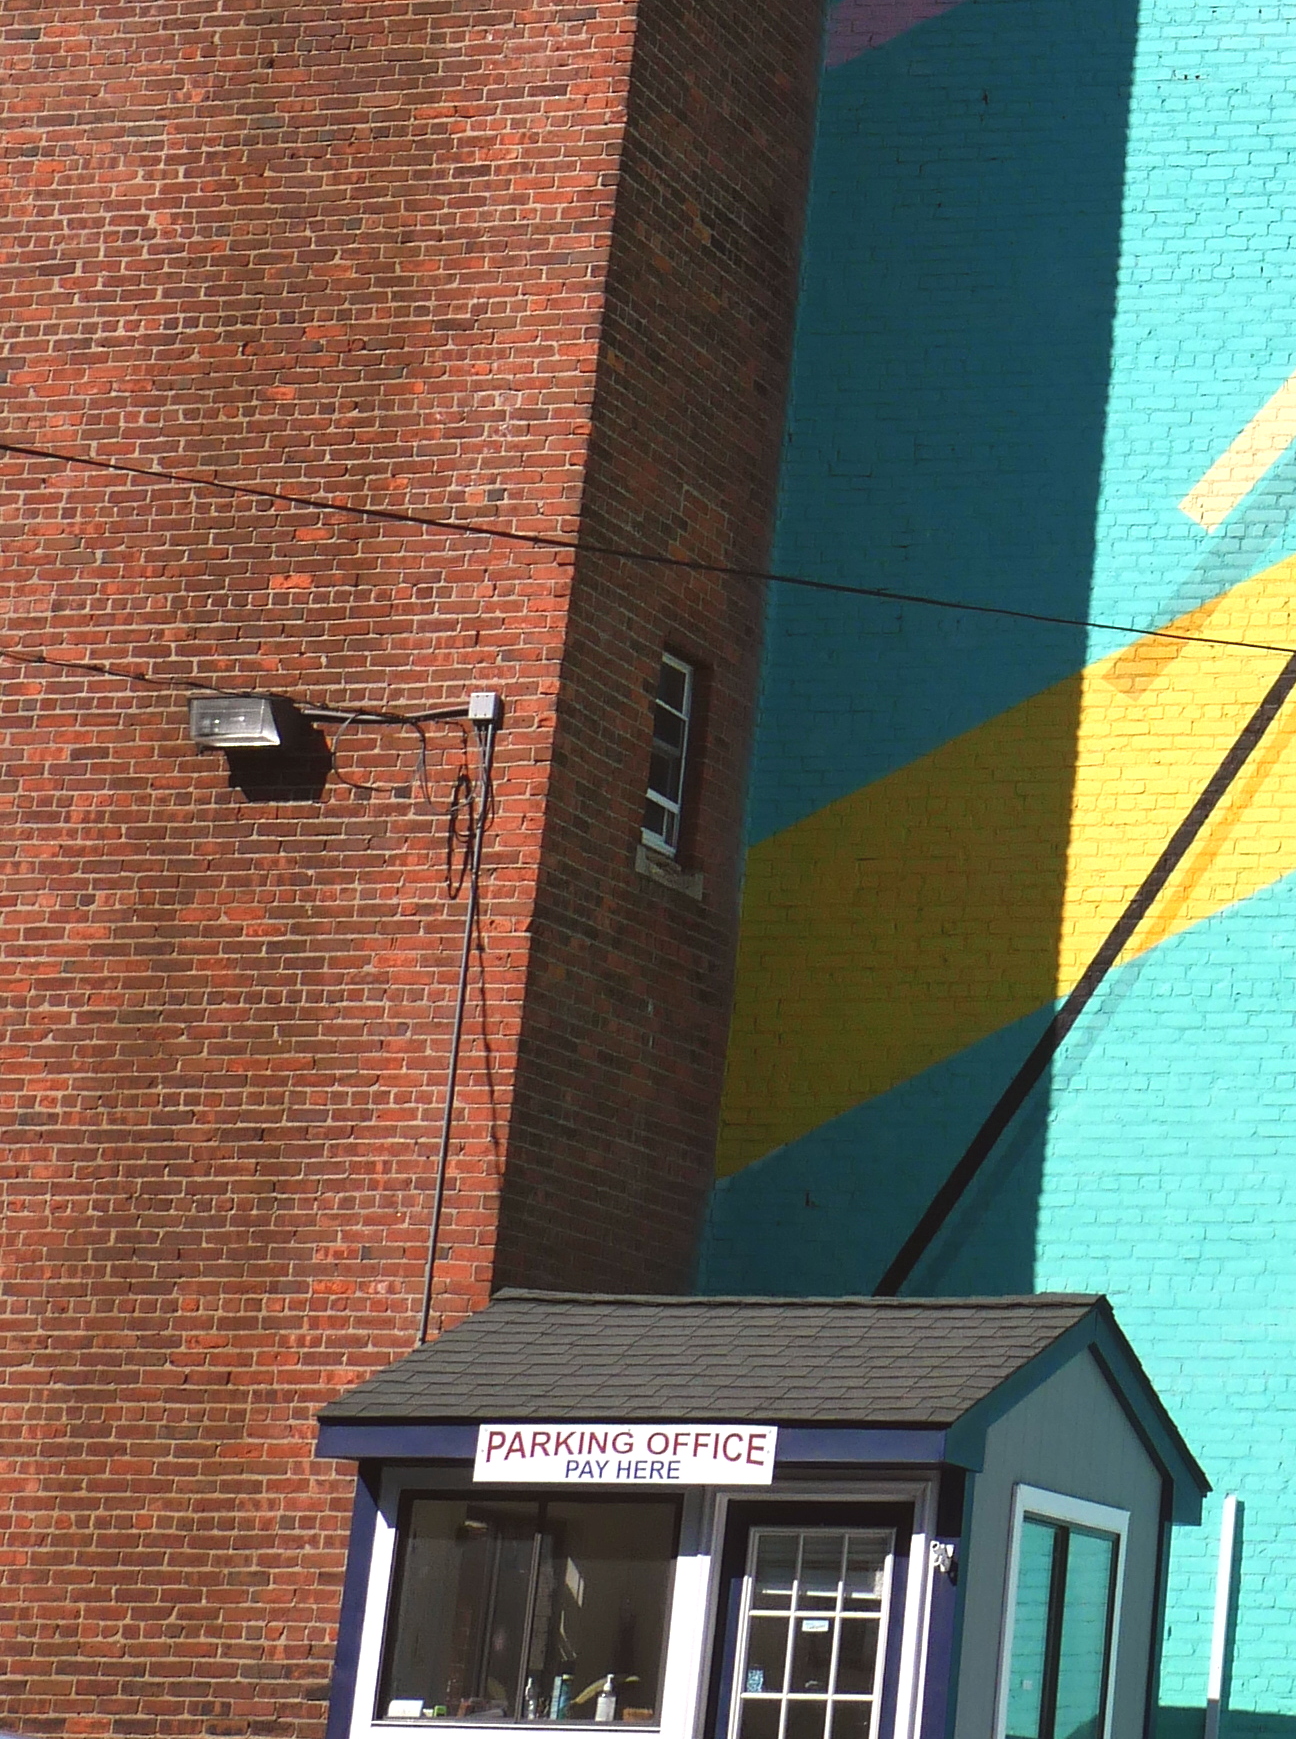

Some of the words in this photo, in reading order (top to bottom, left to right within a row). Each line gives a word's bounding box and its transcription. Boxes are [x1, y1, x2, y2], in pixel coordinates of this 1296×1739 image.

[486, 1430, 634, 1463] PARKING
[646, 1432, 767, 1466] OFFICE
[564, 1459, 609, 1479] PAY
[616, 1460, 681, 1480] HERE
